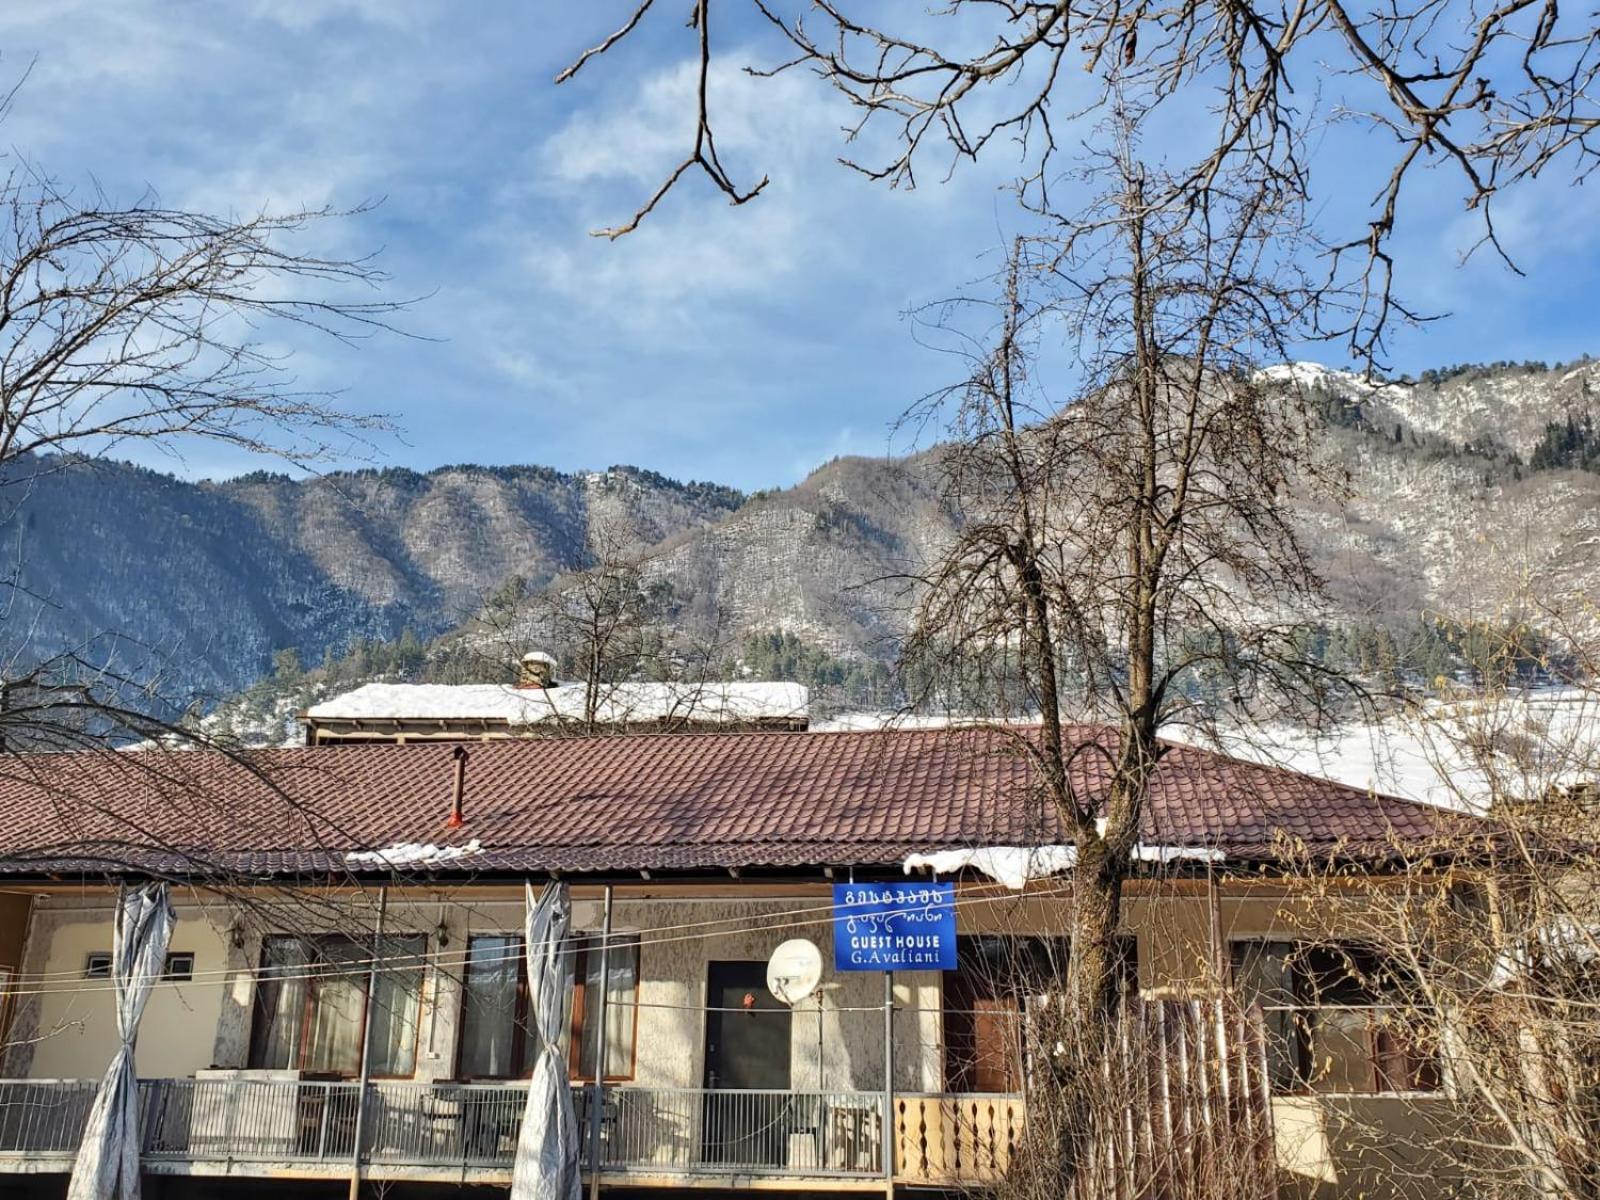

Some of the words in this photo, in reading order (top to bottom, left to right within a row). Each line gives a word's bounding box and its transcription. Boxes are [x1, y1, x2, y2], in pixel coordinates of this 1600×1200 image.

[851, 936, 892, 948] GUEST
[896, 936, 940, 948] HOUSE
[851, 949, 940, 964] G.Avaliani
